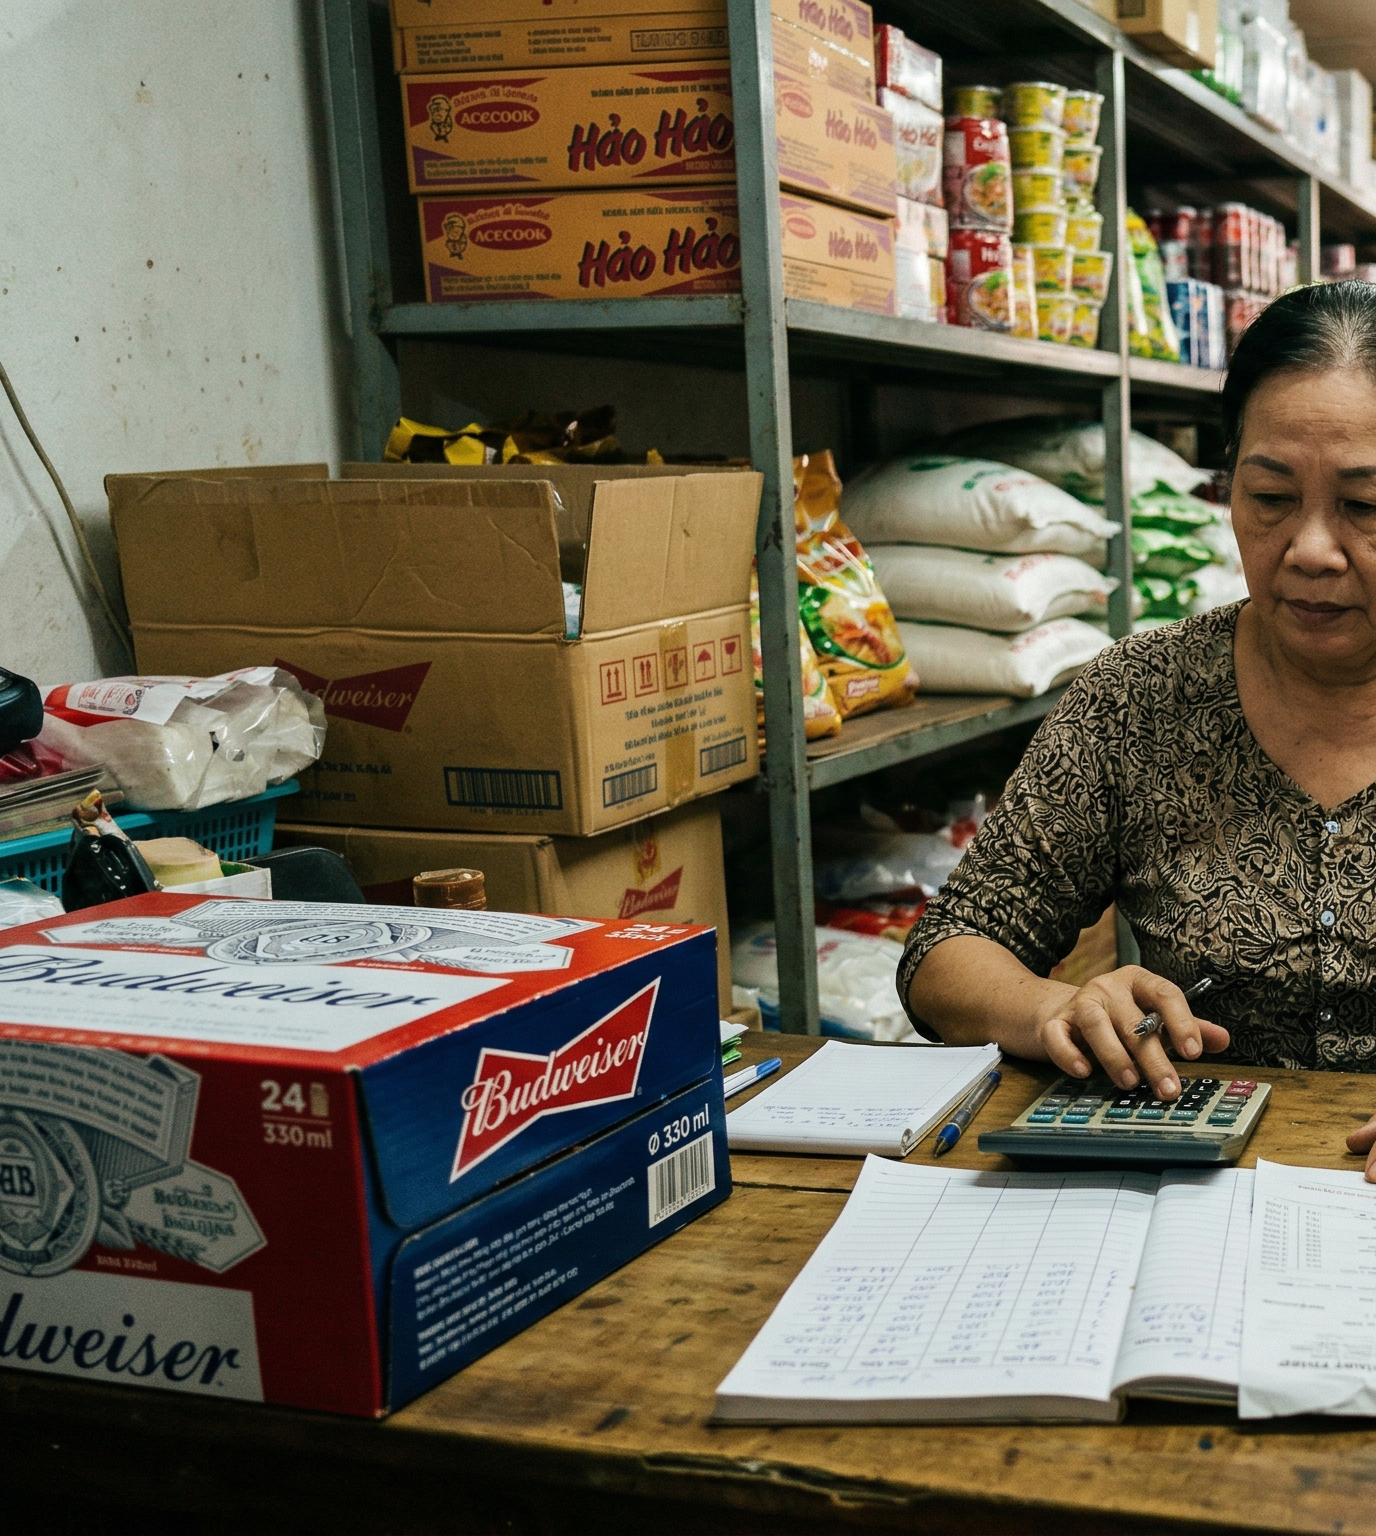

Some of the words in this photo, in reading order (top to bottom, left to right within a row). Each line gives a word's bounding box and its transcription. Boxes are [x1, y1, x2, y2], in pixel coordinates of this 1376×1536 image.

[460, 109, 535, 125] ACECOOK
[567, 112, 648, 173] Hảo
[654, 97, 735, 159] Hảo
[475, 227, 548, 243] ACECOOK
[578, 230, 656, 289] Hảo
[663, 217, 741, 276] Hảo
[260, 1080, 306, 1114] 24
[461, 1031, 647, 1137] Budweiser
[663, 1115, 690, 1148] 330
[693, 1102, 710, 1132] ml
